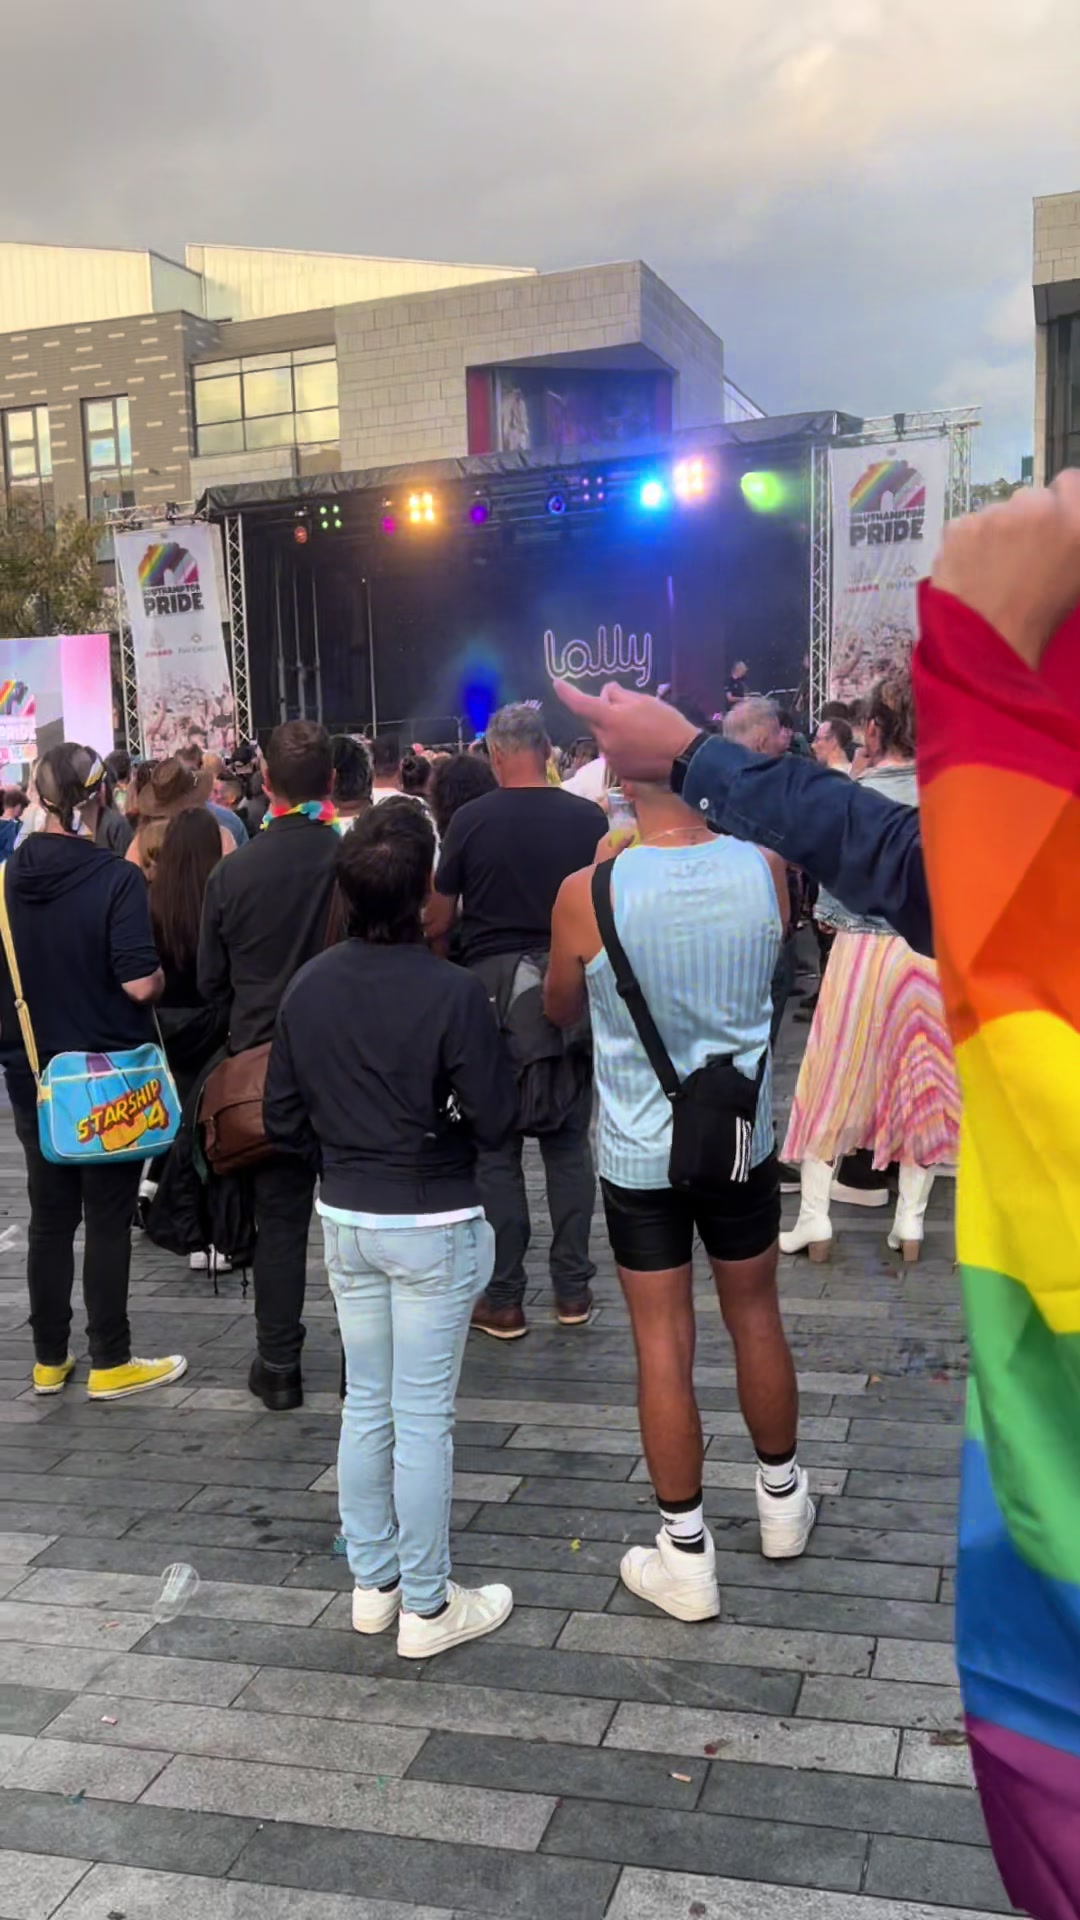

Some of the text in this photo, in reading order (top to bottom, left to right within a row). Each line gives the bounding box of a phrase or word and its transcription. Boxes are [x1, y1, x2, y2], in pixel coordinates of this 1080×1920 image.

[850, 518, 925, 547] PRIDE
[143, 592, 205, 618] PRIDE
[77, 1078, 162, 1144] STARSHIP
